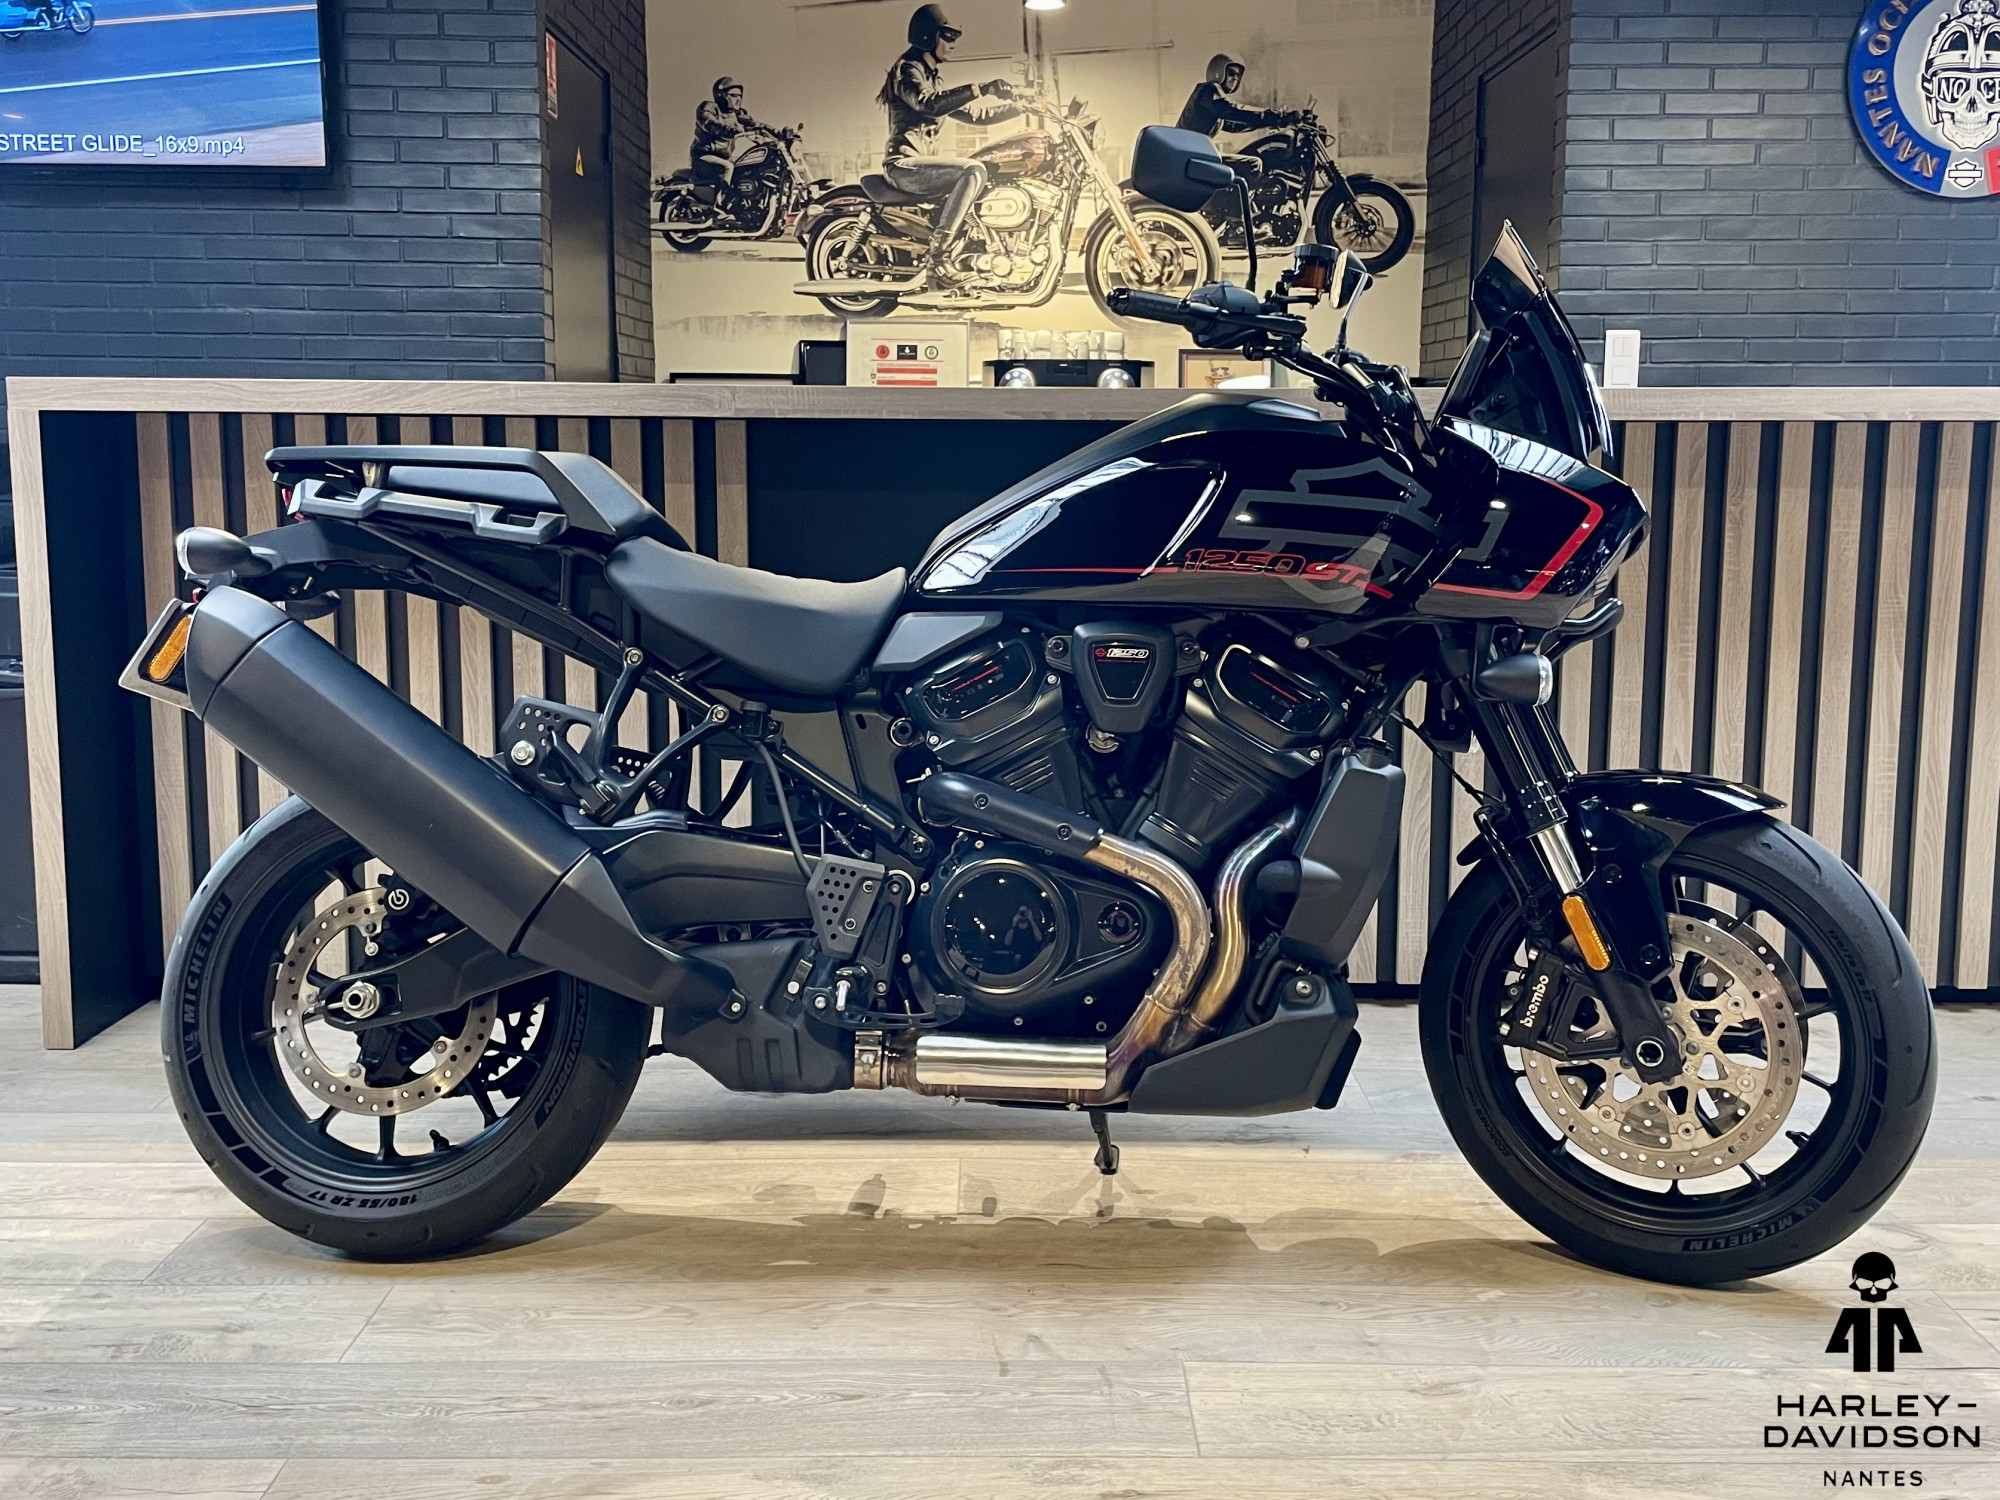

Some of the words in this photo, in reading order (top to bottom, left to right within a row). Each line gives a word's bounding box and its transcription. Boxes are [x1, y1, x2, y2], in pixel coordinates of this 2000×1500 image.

[1939, 78, 1967, 102] NO
[1863, 68, 1940, 178] NANTES
[0, 134, 76, 152] STREET
[82, 134, 245, 157] GLIDE_16x9.mp4
[183, 901, 227, 1024] MICHELIN
[1520, 975, 1549, 1028] brembo
[307, 1190, 329, 1202] 17
[330, 1195, 353, 1208] ZR
[357, 1194, 419, 1209] 180/55
[1689, 1215, 1794, 1251] MICHELIN
